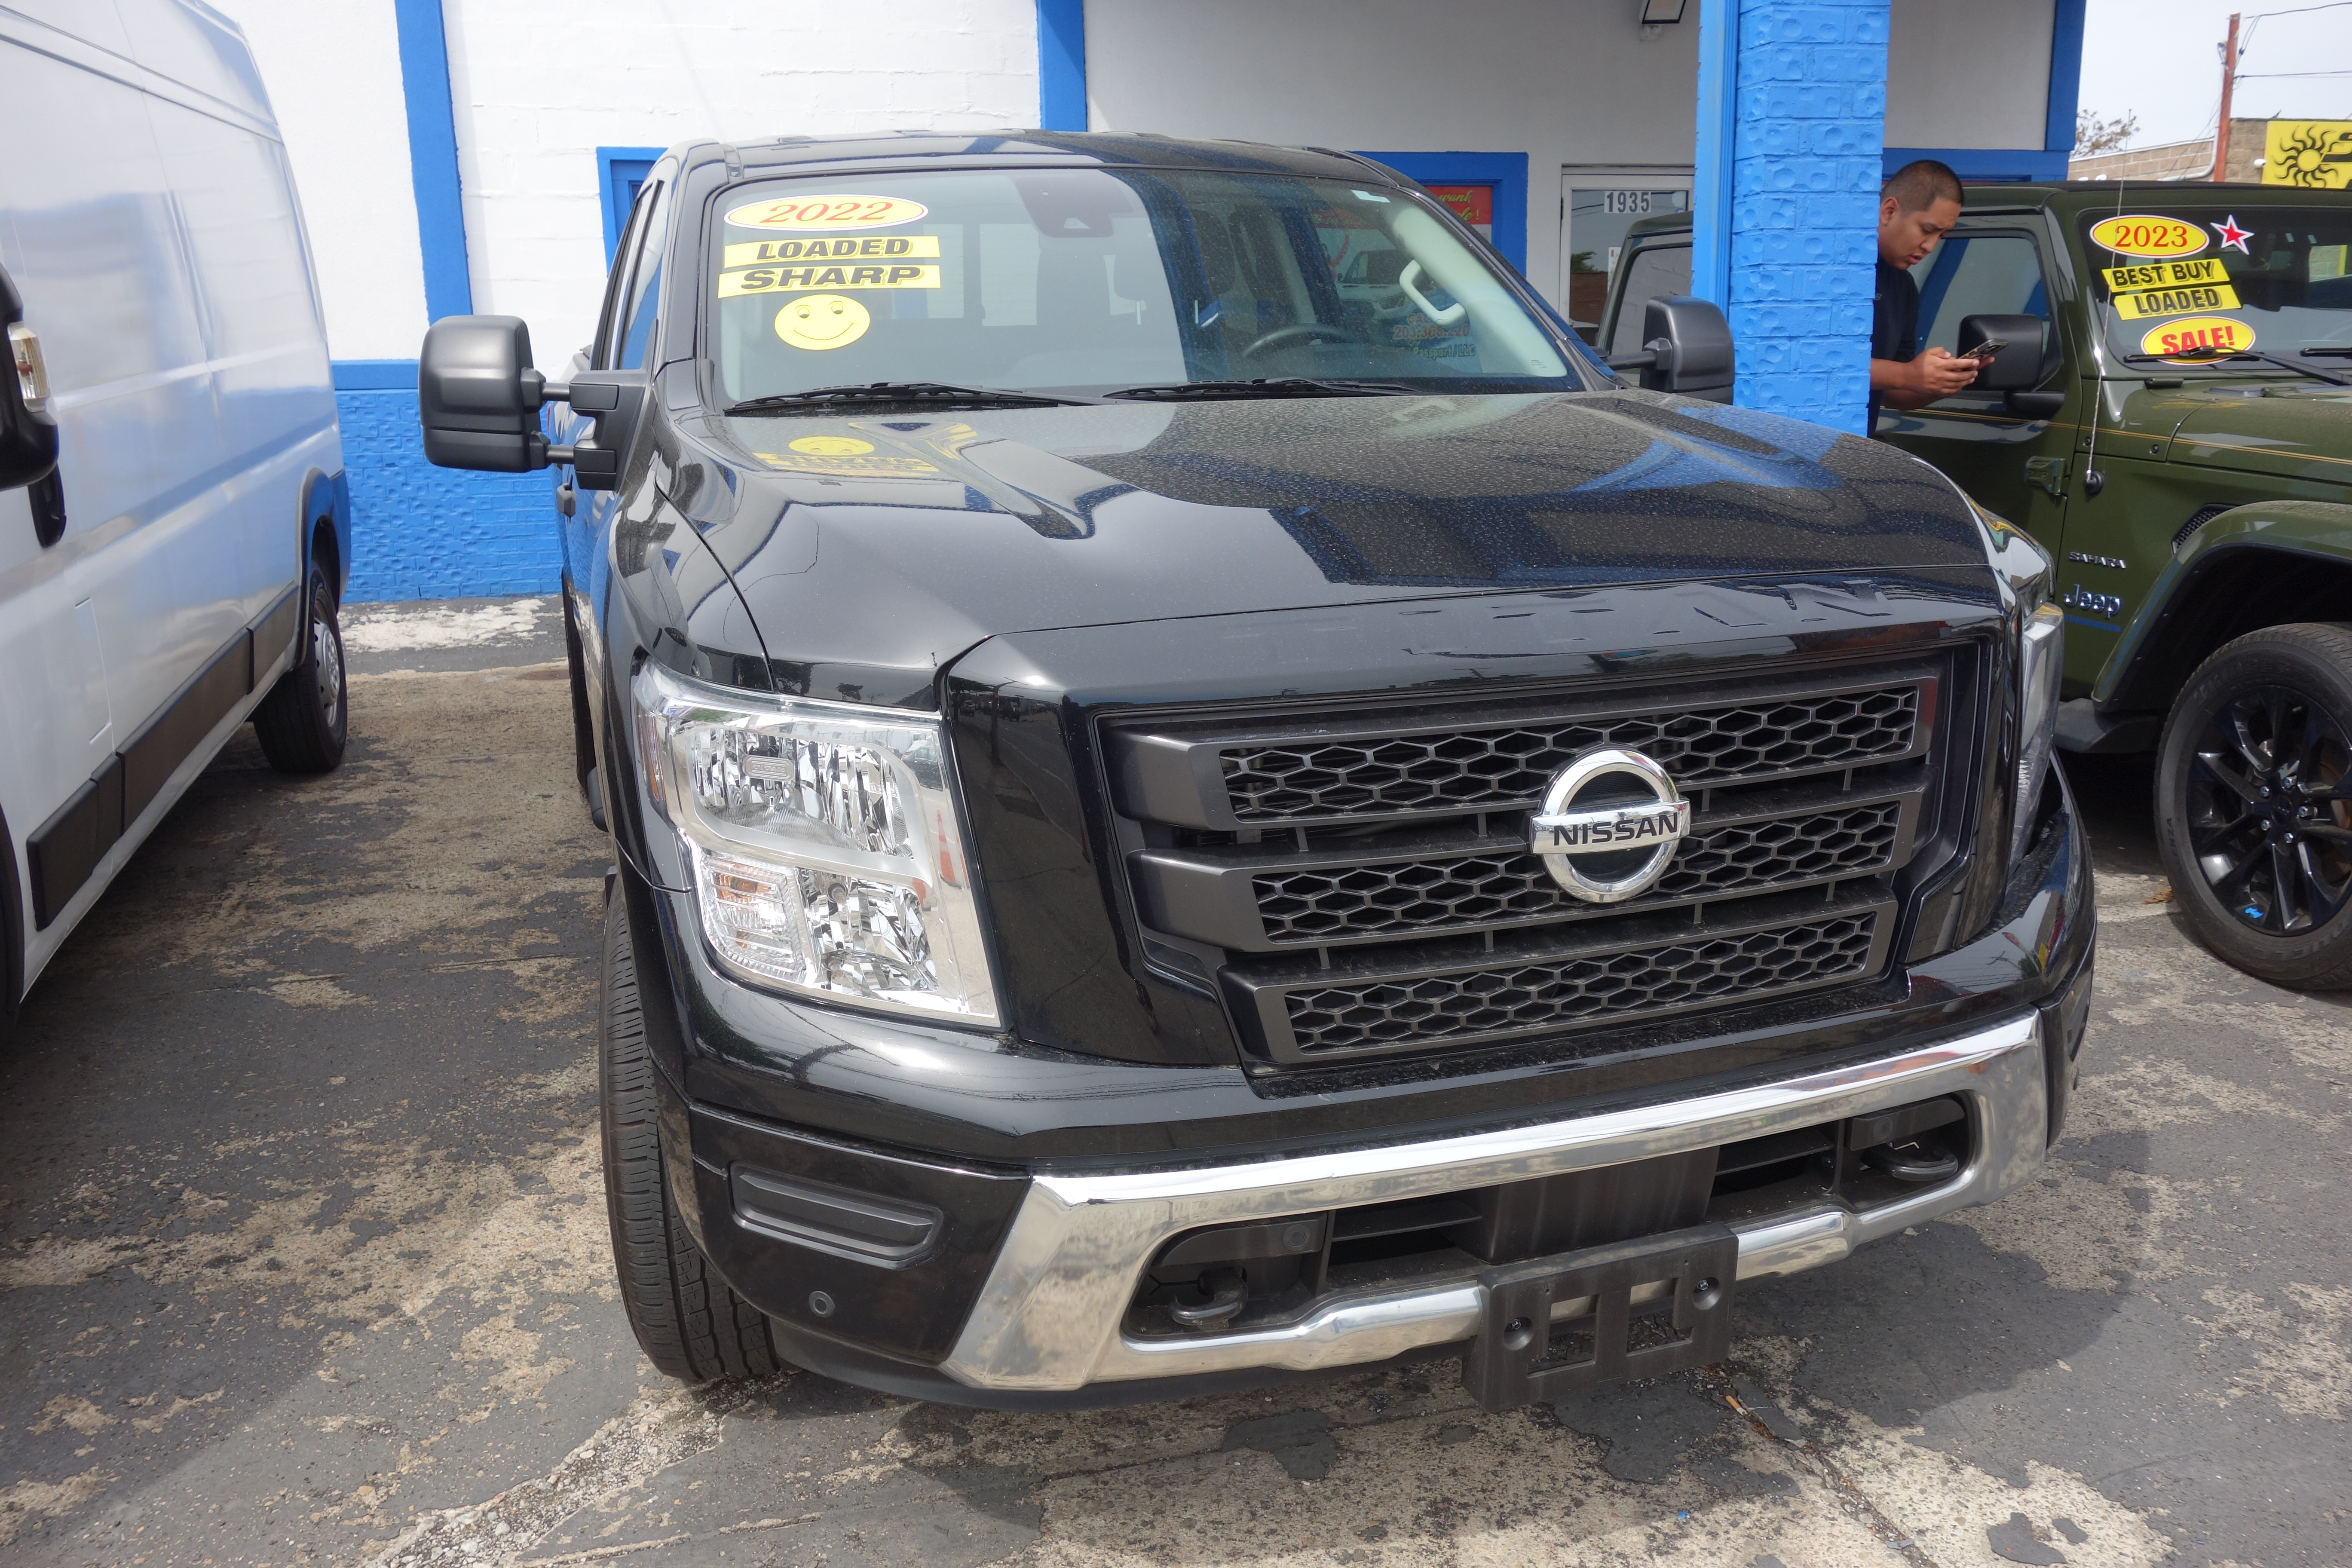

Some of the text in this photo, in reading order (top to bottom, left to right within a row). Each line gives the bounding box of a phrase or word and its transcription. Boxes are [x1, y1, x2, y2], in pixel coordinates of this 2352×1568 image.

[759, 202, 893, 223] 2022
[1607, 192, 1650, 212] 1935
[2115, 225, 2188, 247] 2023
[756, 239, 911, 260] LOADED
[741, 266, 922, 290] SHARP
[2112, 261, 2214, 287] BEST BUY
[2134, 288, 2221, 315] LOADED
[2161, 325, 2235, 355] SALE!
[2068, 551, 2127, 570] SAHARA
[2064, 583, 2122, 619] Jeep
[753, 764, 785, 772] TITAN
[1553, 812, 1678, 846] NISSAN
